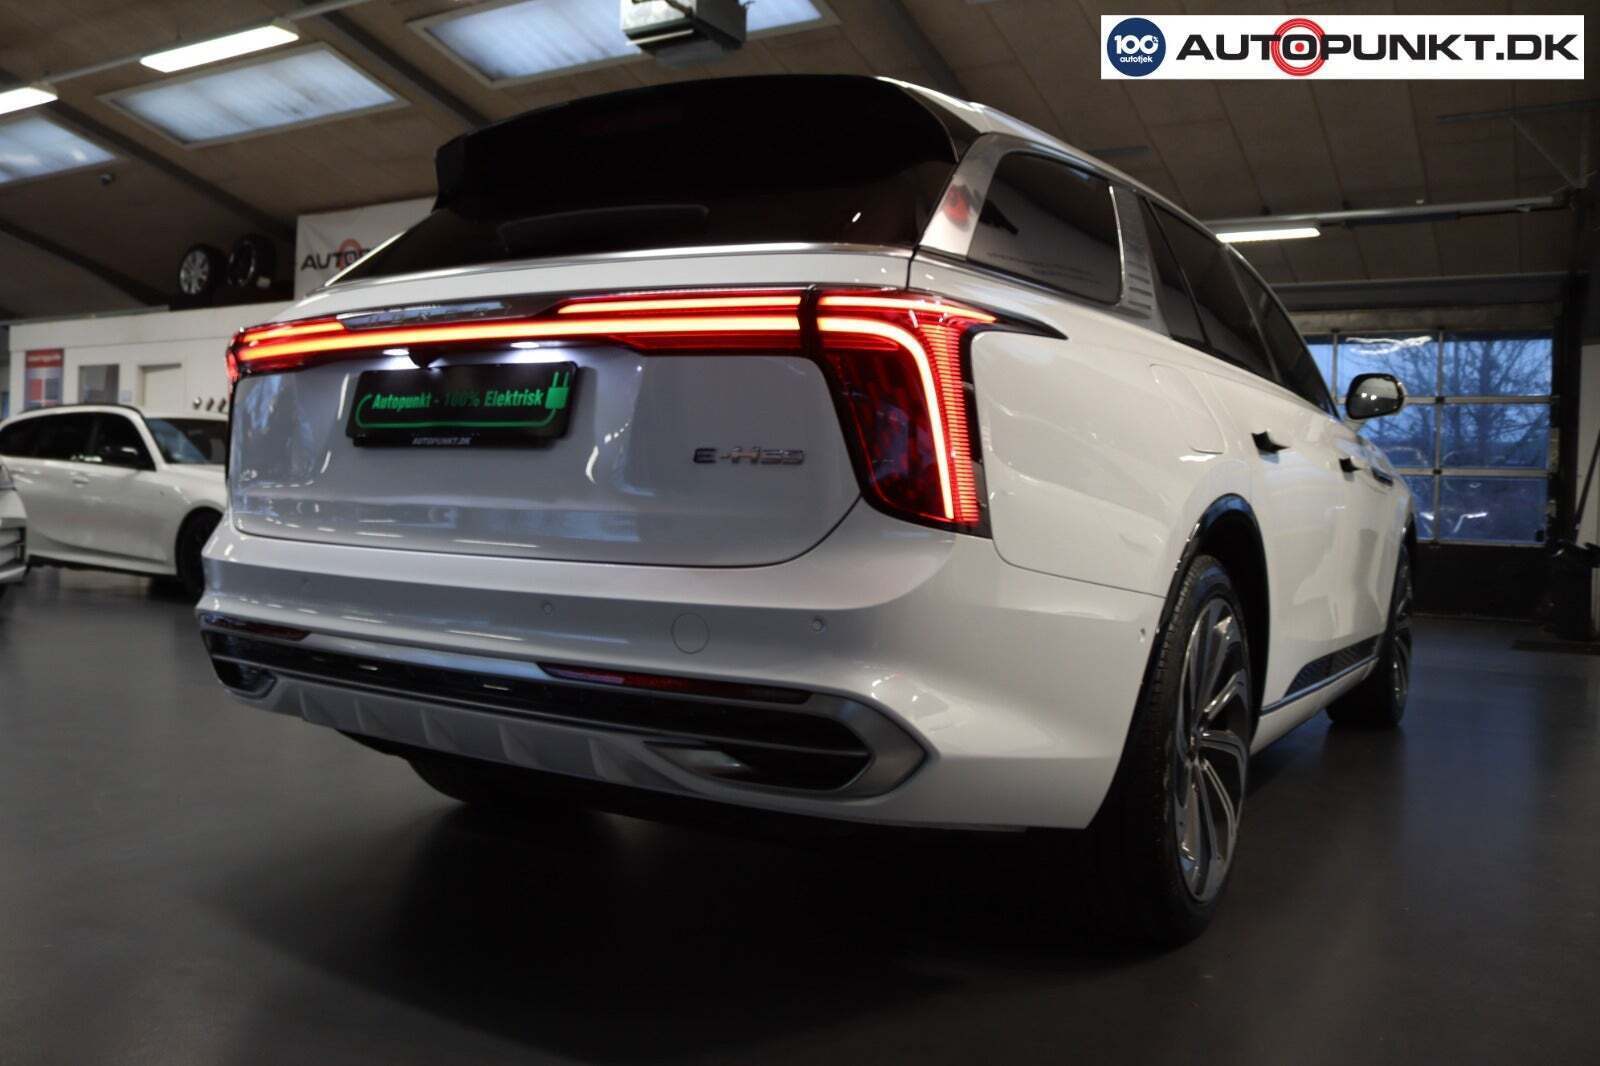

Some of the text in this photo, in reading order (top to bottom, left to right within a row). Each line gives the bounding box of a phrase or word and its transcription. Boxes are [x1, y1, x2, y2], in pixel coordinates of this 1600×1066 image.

[371, 392, 433, 412] Autopunkt
[443, 390, 481, 407] 100%
[483, 389, 543, 408] Elektrisk
